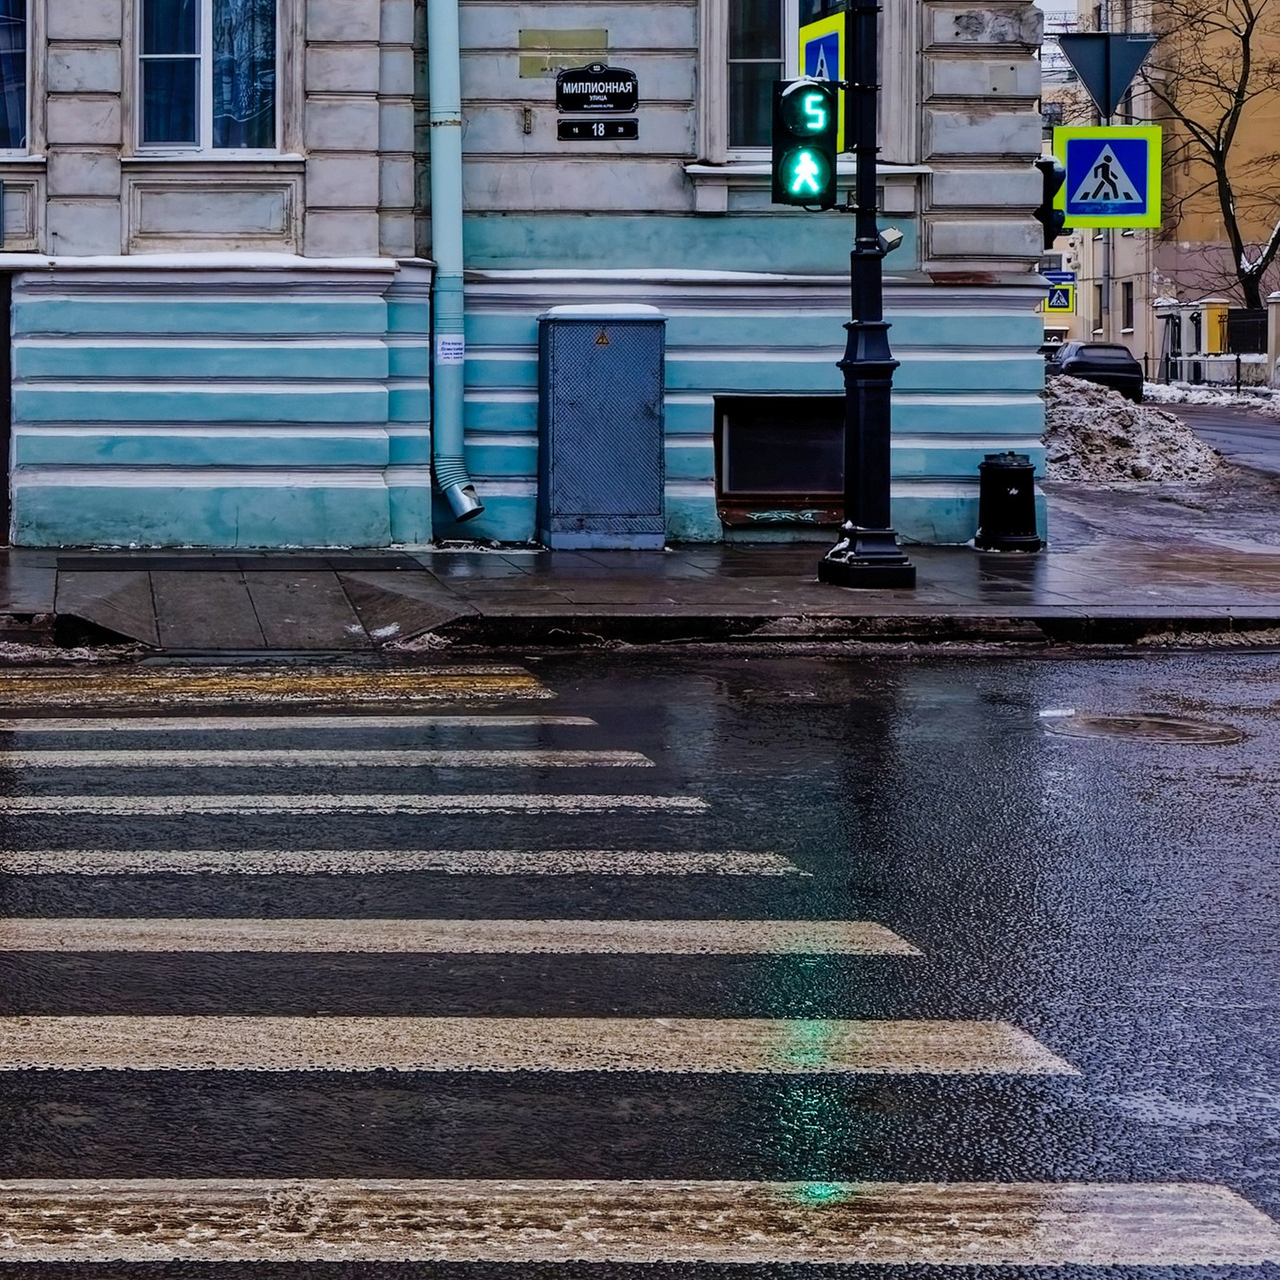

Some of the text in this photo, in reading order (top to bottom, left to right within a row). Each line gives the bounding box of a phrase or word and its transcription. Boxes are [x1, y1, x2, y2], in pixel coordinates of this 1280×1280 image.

[562, 81, 633, 94] МИЛЛИОННАЯ
[805, 94, 825, 129] 5
[592, 122, 605, 136] 18
